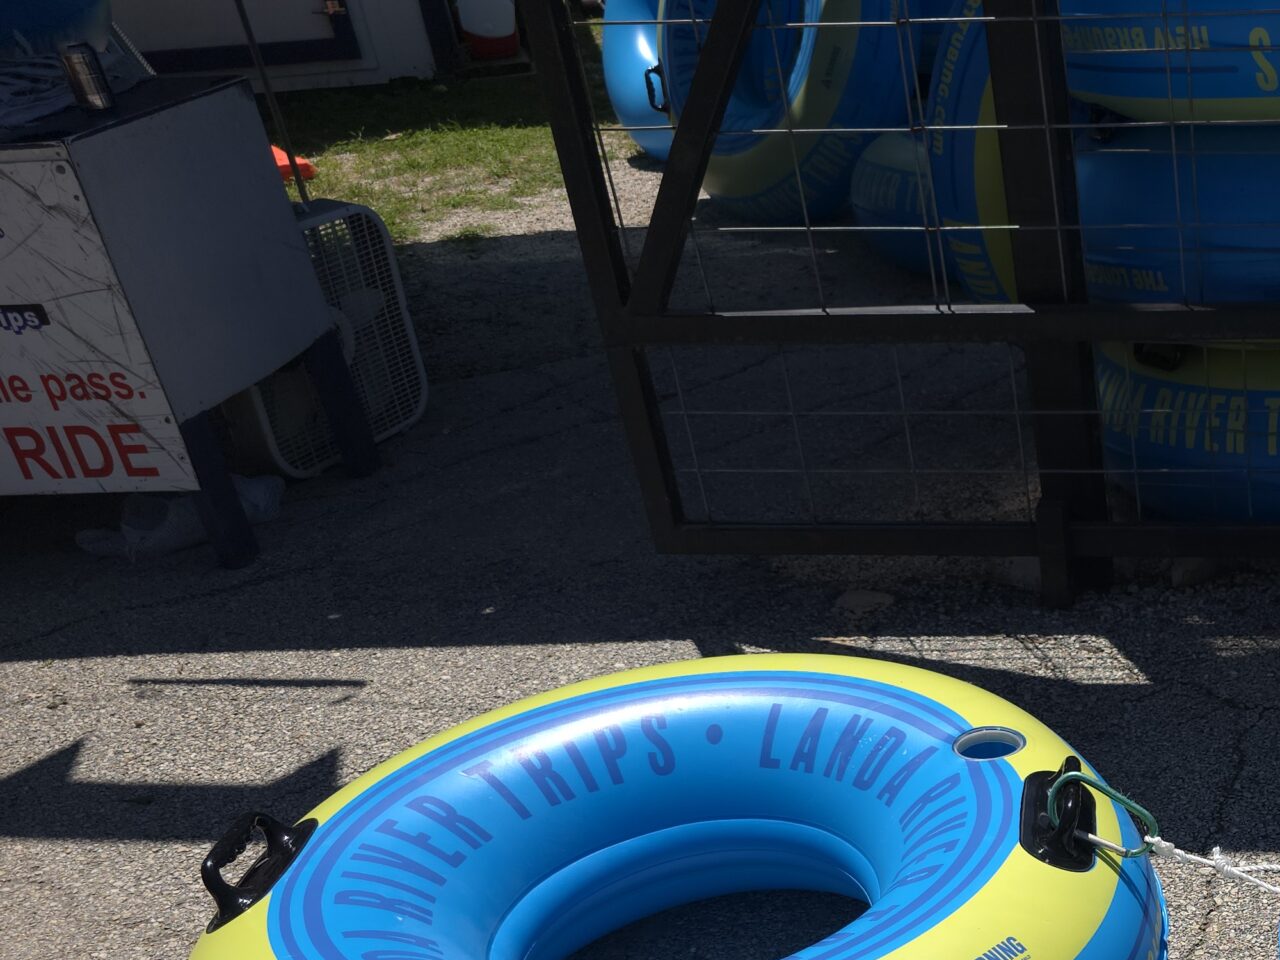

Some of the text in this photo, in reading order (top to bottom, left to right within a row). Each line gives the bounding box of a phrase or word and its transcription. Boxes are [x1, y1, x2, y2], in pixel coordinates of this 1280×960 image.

[40, 372, 147, 411] pass.
[1150, 387, 1246, 454] RIVER
[3, 424, 160, 480] RIDE
[333, 795, 493, 926] RIVER
[461, 713, 676, 820] TRIPS
[759, 703, 940, 808] LANDA
